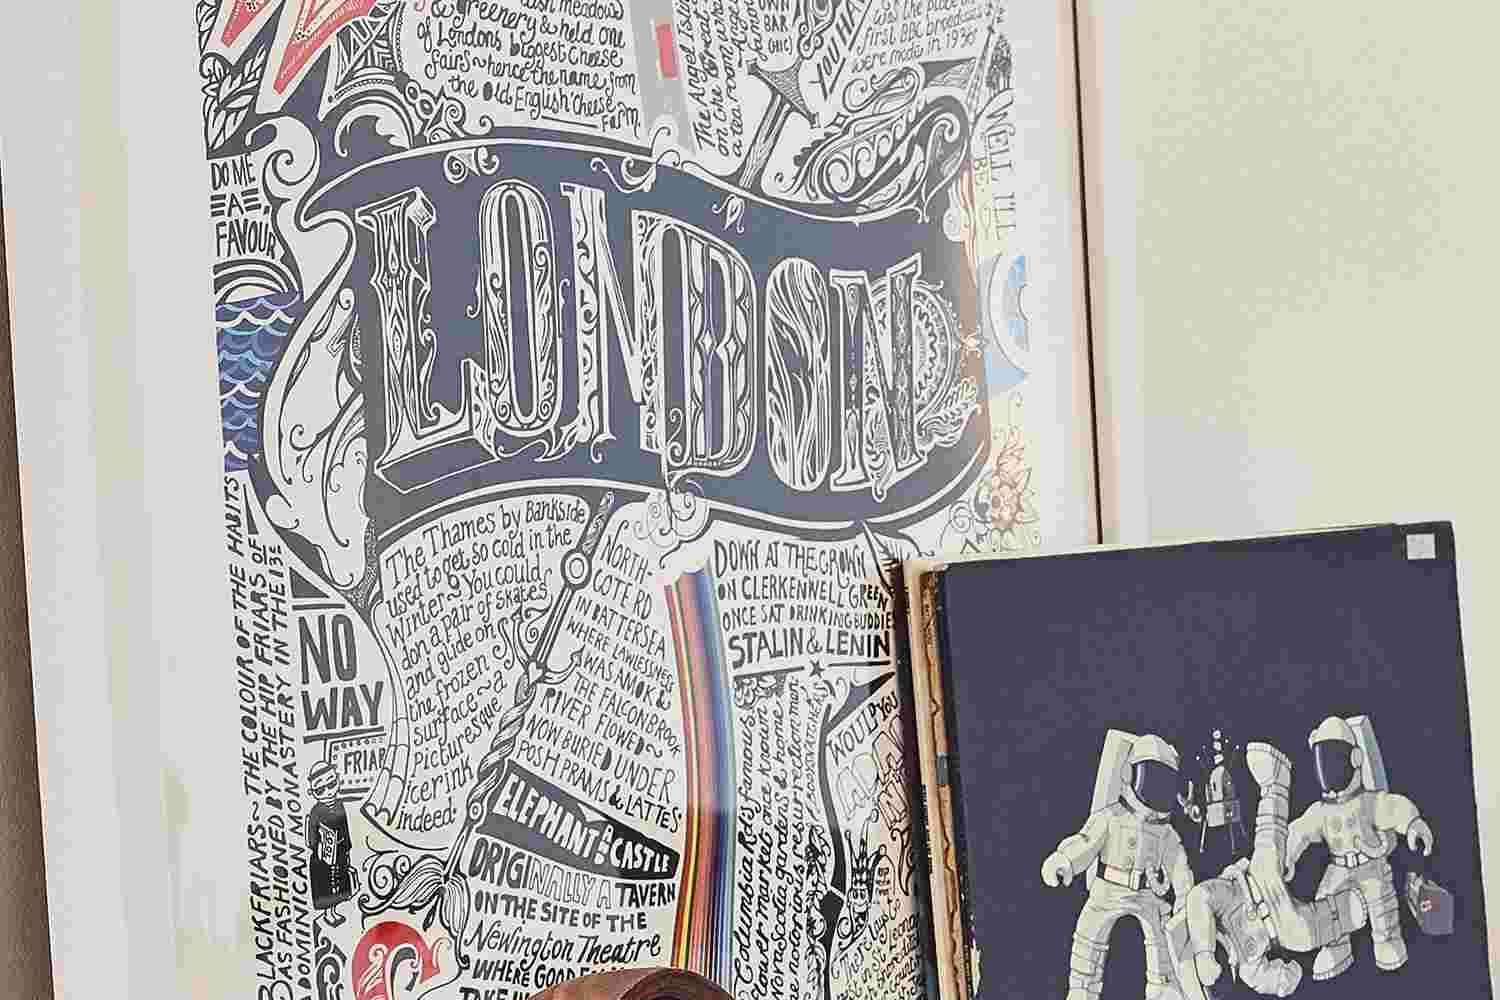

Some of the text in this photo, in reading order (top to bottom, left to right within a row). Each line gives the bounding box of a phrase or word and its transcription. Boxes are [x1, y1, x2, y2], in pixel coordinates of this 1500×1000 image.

[764, 14, 789, 32] BAR
[448, 75, 479, 98] the
[692, 109, 717, 151] The
[210, 152, 257, 191] DO ME
[227, 192, 245, 218] A
[214, 217, 277, 260] FAVOUR
[355, 180, 932, 493] LONDON
[385, 546, 427, 590] The
[422, 511, 496, 558] Thames
[499, 504, 522, 540] by
[386, 573, 423, 618] used
[528, 527, 546, 551] in
[546, 523, 574, 550] the
[494, 552, 543, 587] could
[764, 541, 783, 568] AT
[782, 541, 818, 578] THE
[268, 581, 289, 632] THE
[476, 591, 493, 625] of
[592, 569, 634, 609] COTE
[717, 575, 889, 612] ON CLERKENWELL GREEN
[224, 475, 263, 797] THE COLOUR OF THE HABITS
[249, 573, 273, 667] FRIARS
[565, 615, 611, 652] WHERE
[574, 595, 666, 662] IN BATTERSEA
[722, 605, 757, 633] ONCE
[760, 603, 785, 625] SAT
[788, 604, 853, 630] DRINKING
[272, 637, 291, 667] IN
[299, 613, 358, 685] NO
[404, 621, 498, 702] and glide on
[727, 626, 891, 671] STALIN & LENIN
[257, 672, 278, 718] HIP
[434, 654, 491, 702] frozen
[573, 671, 601, 703] THE
[582, 653, 656, 708] WAS AMOK
[300, 680, 385, 731] WAY
[540, 686, 645, 757] RIVER FLOWED
[827, 690, 899, 764] WOULD YOU
[260, 721, 280, 769] THE
[274, 674, 304, 837] MONASTERY
[525, 713, 676, 805] NOW BURIED UNDER
[515, 738, 562, 778] POSH
[559, 758, 611, 803] PRAMS
[263, 779, 284, 811] BY
[492, 772, 600, 859] ELEPHANT
[610, 838, 672, 874] CASTLE
[266, 813, 294, 950] FASHIONED
[468, 837, 597, 907] ORIGINALLY
[615, 881, 676, 910] TAVERN
[288, 845, 314, 991] DOMINICAN
[474, 889, 648, 934] ON THE SITE OF THE
[276, 950, 294, 981] AS
[577, 932, 661, 966] Theatre
[471, 958, 531, 990] WHERE
